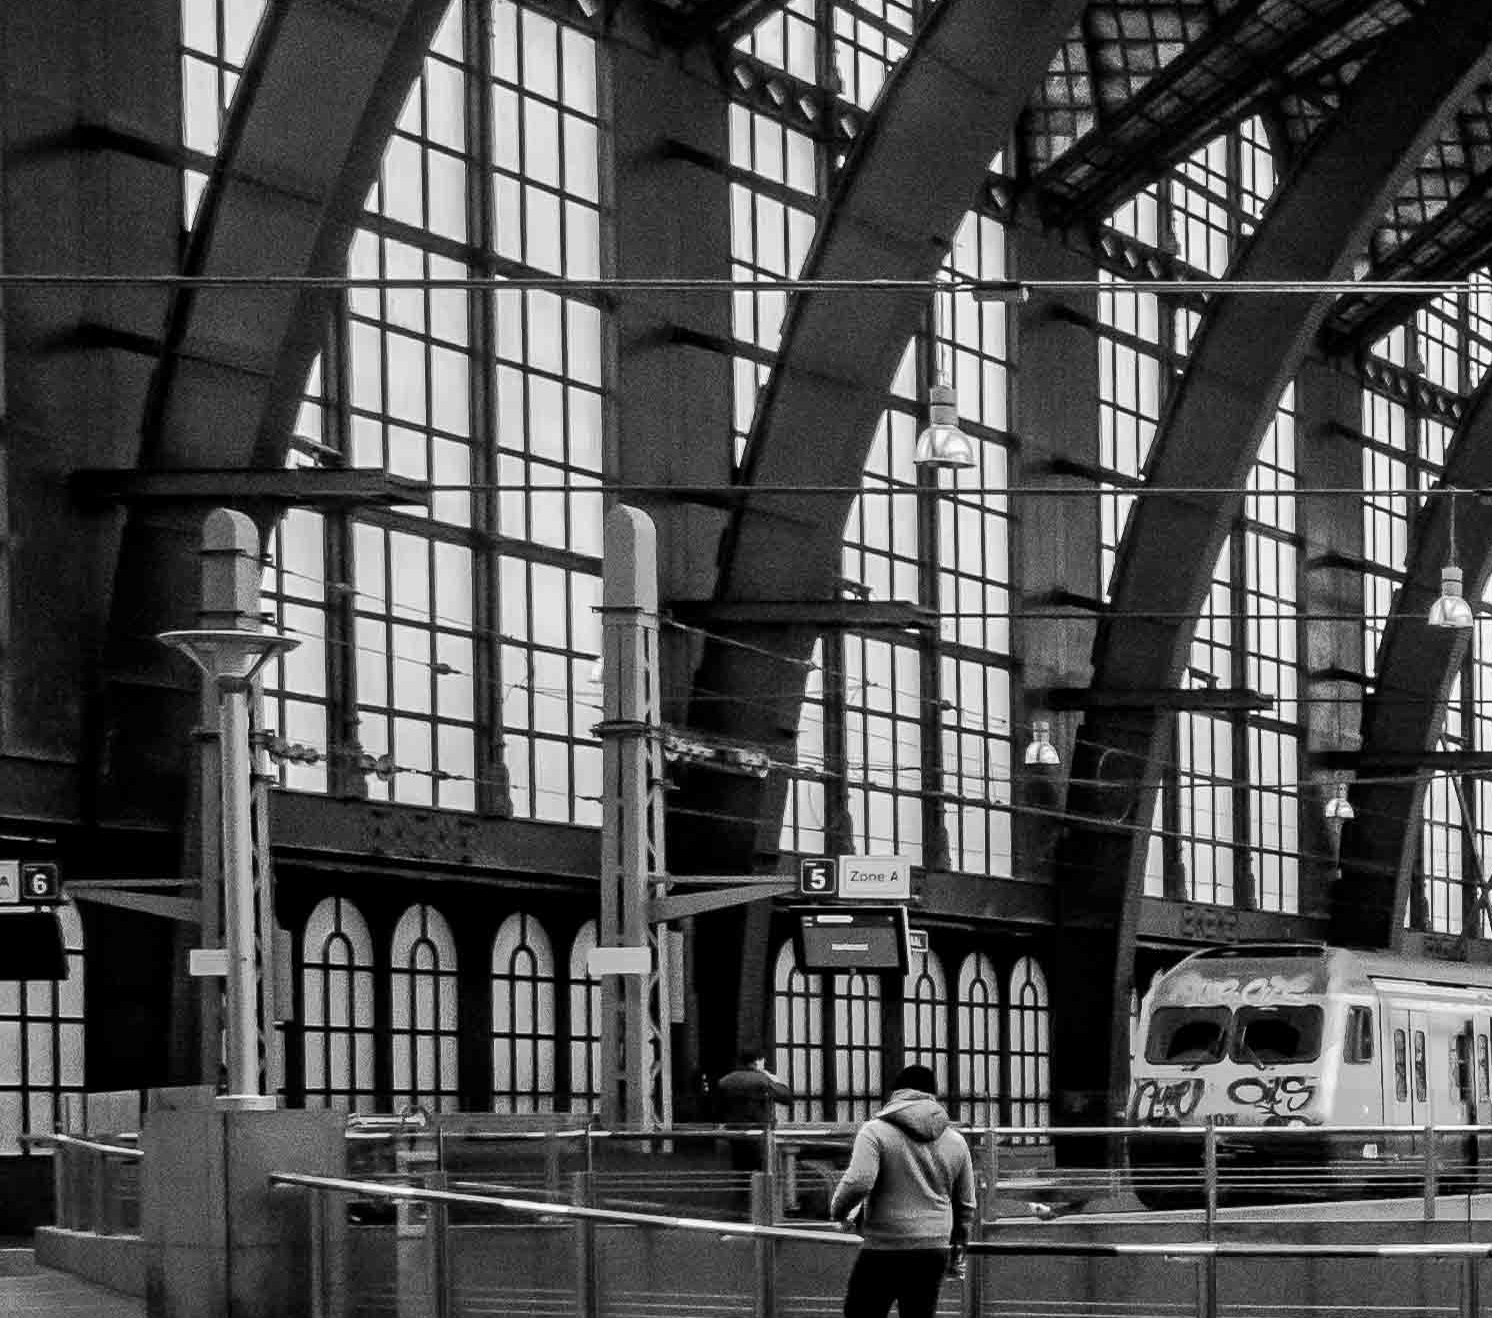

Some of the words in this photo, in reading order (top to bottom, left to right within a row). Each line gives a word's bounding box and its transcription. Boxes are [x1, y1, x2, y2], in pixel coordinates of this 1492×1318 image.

[33, 873, 47, 894] 6
[811, 869, 826, 890] 5
[850, 870, 885, 882] Zone
